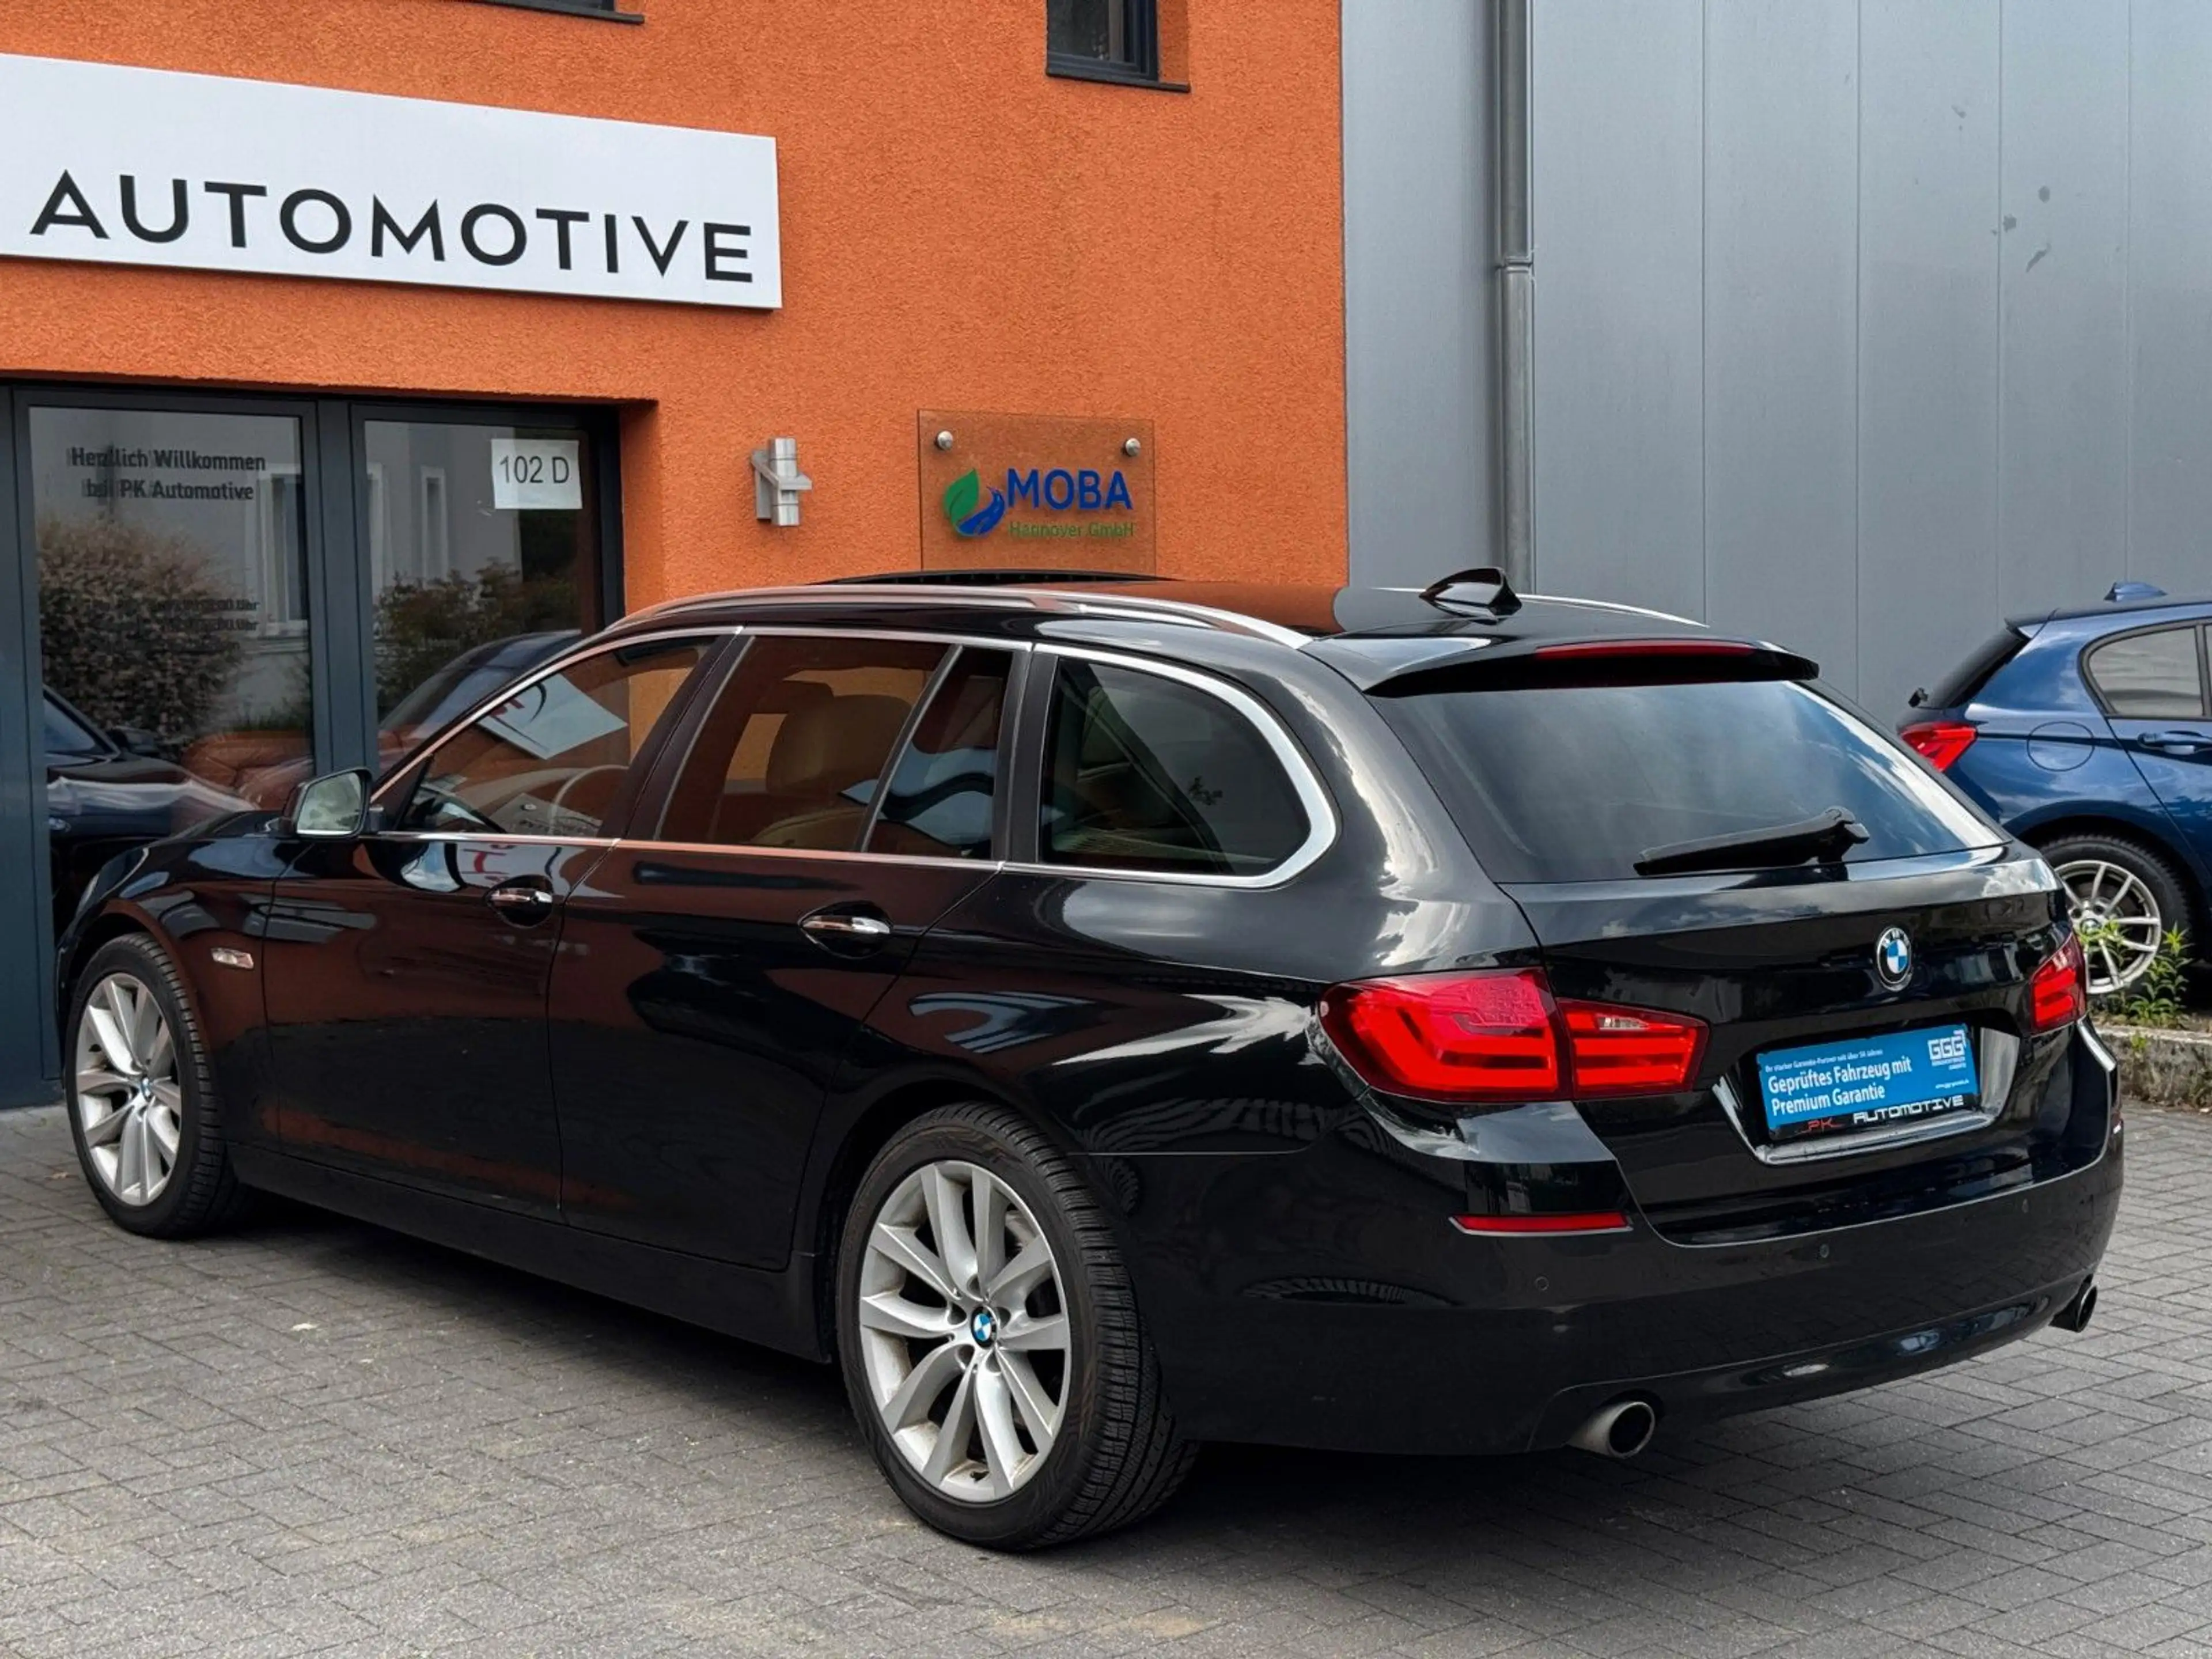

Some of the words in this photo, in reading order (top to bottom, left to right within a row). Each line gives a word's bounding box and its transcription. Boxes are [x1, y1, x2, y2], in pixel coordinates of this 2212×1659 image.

[30, 168, 753, 283] AUTOMOTIVE
[153, 449, 266, 471] Willkommen
[500, 456, 543, 483] 102
[552, 457, 570, 483] D
[120, 479, 147, 499] PK
[151, 480, 253, 501] Automotive
[1007, 468, 1132, 510] MOBA
[1010, 522, 1082, 537] Hannover
[1089, 523, 1133, 537] GmbH
[1928, 1036, 1964, 1060] GGG
[1768, 1069, 1832, 1096] Geprüftes
[1835, 1061, 1891, 1081] Fahrzeug
[1892, 1056, 1912, 1073] mit
[1772, 1092, 1830, 1116] Premium
[1832, 1082, 1885, 1105] Garantie
[1806, 1118, 1840, 1132] PK
[1853, 1095, 1964, 1124] AUTOMOTIVE
